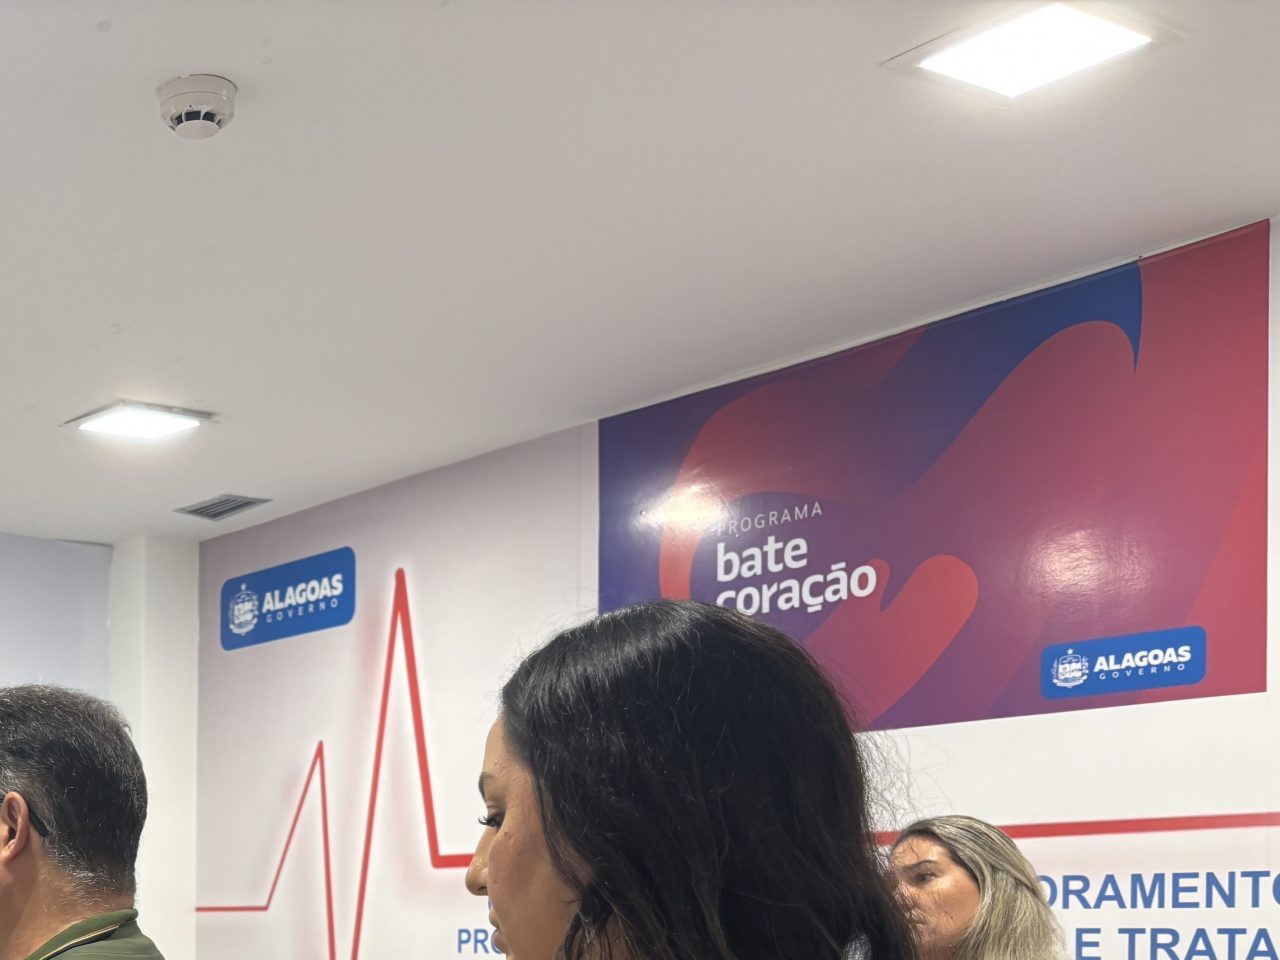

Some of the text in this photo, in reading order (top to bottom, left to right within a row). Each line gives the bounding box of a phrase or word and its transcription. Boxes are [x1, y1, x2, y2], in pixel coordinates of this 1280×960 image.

[717, 501, 823, 536] PROGRAMA
[716, 535, 808, 582] bate
[261, 573, 344, 613] ALAGOAS
[266, 598, 338, 623] GOVERNO
[1093, 645, 1192, 673] ALAGOAS
[1099, 663, 1185, 680] GOVERNO
[1037, 870, 1280, 910] RAMENT
